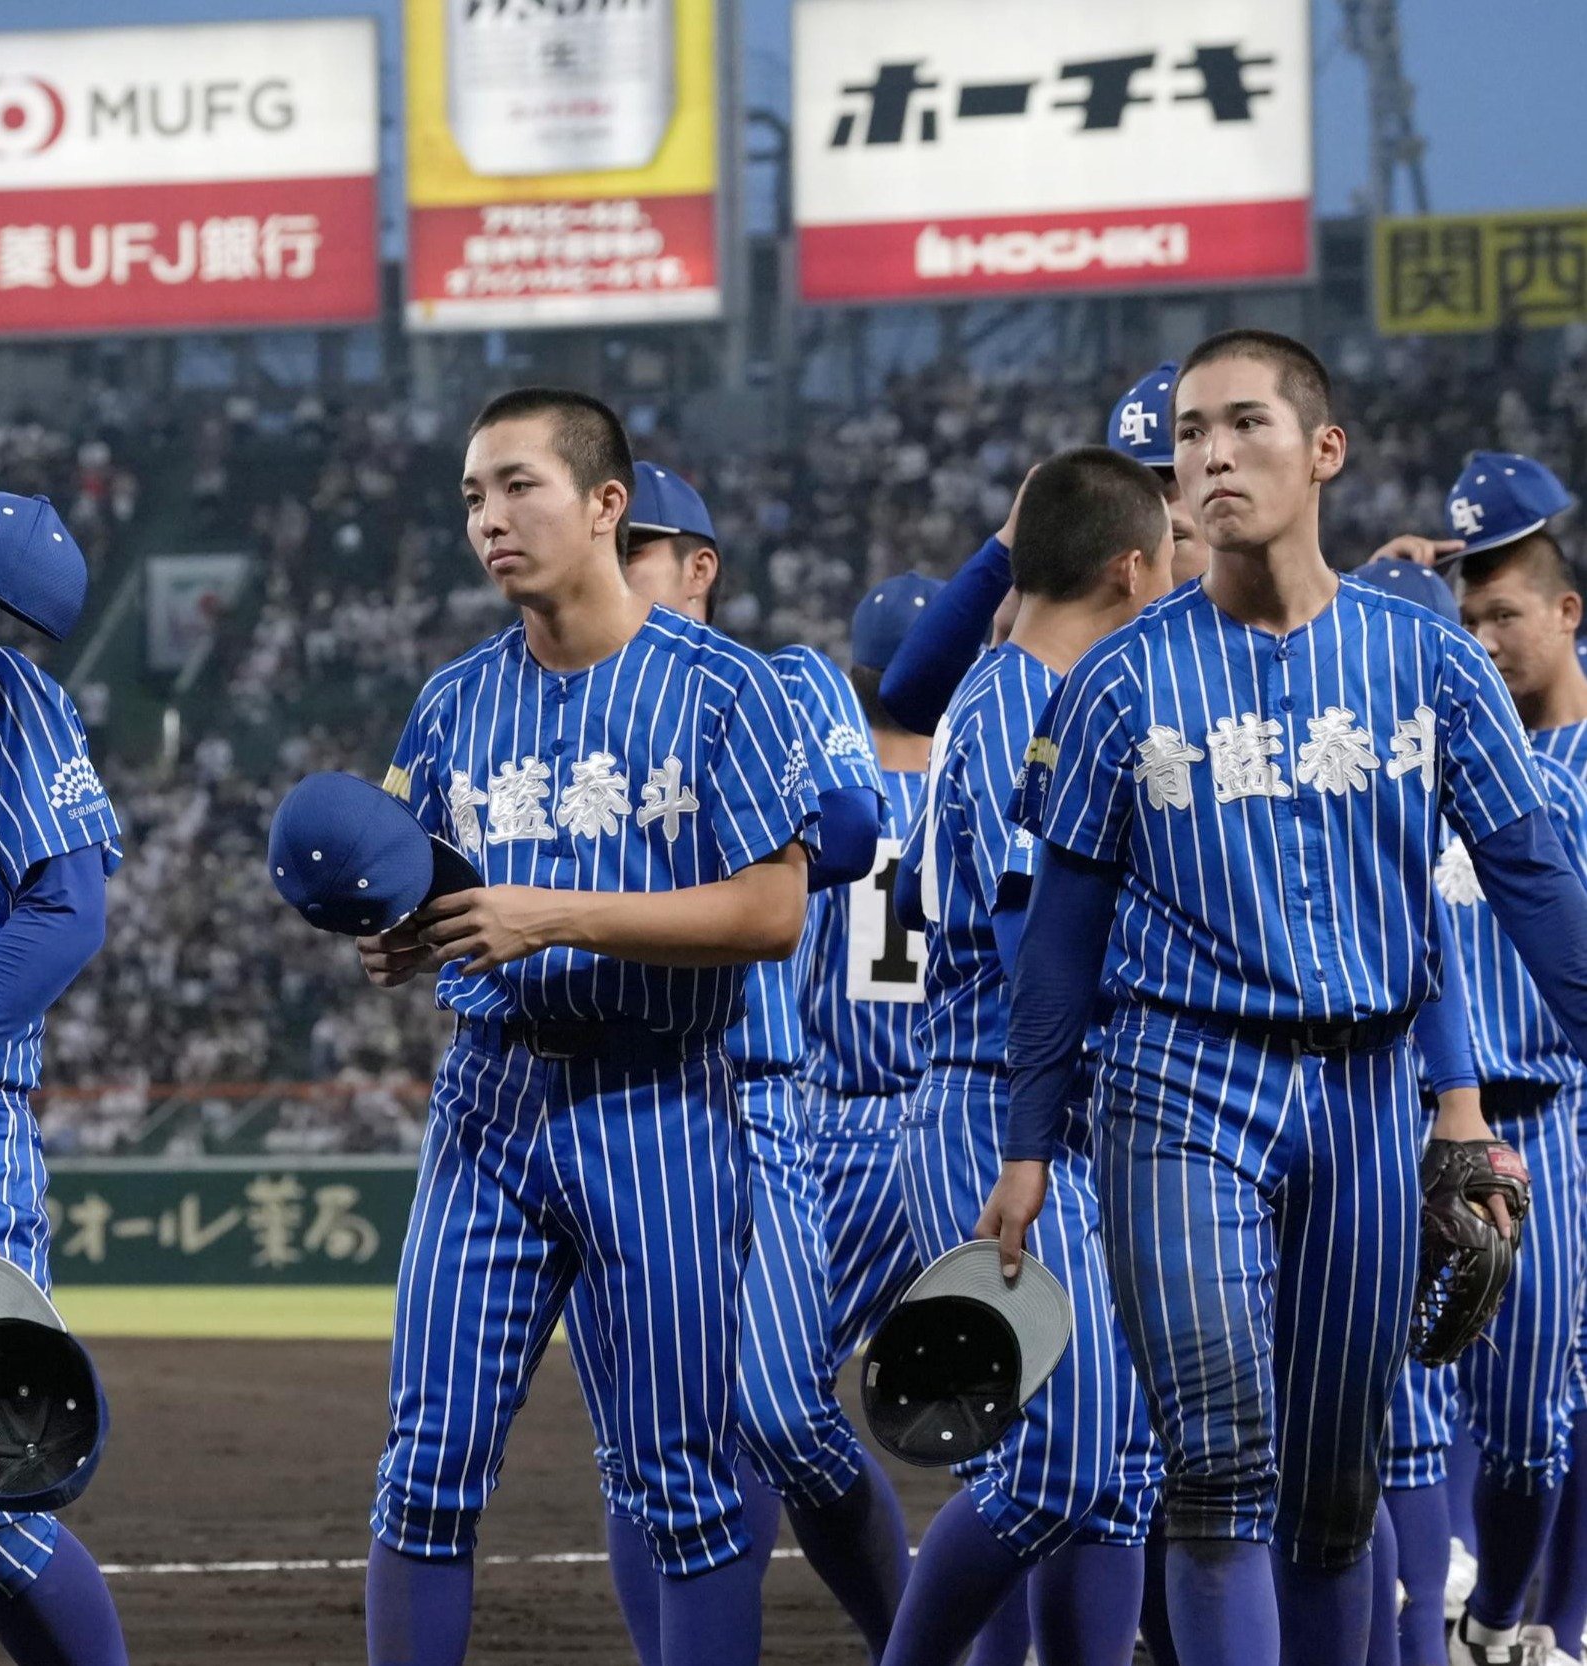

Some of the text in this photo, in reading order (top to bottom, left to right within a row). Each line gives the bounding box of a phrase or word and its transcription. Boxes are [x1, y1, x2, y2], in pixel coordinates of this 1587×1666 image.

[87, 79, 296, 140] MUFG
[829, 44, 1276, 148] ホーチキ
[1387, 221, 1587, 319] 関西
[1119, 400, 1158, 446] ST
